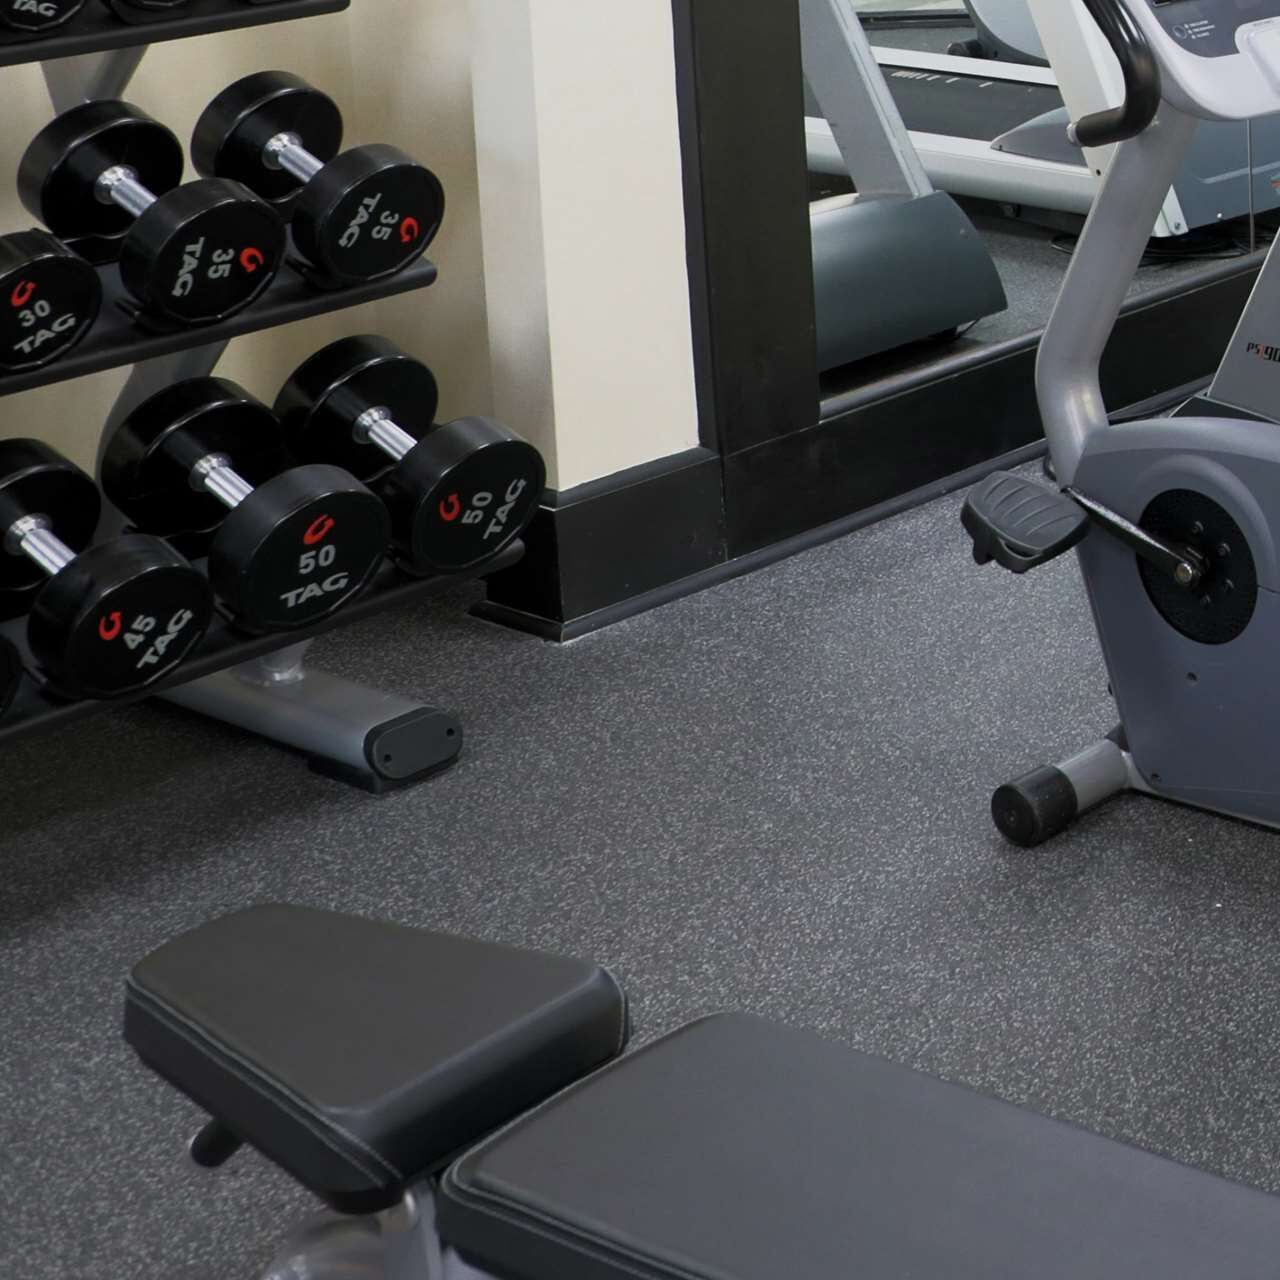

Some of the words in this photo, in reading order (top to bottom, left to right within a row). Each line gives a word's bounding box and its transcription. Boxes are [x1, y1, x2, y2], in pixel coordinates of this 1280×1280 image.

[339, 193, 382, 247] TAG
[371, 210, 399, 240] 35
[172, 237, 205, 297] TAG
[208, 248, 234, 279] 35
[19, 300, 50, 327] 30
[14, 312, 76, 353] TAG
[462, 492, 492, 524] 50
[483, 479, 526, 539] TAG
[299, 545, 335, 574] 50
[280, 572, 348, 607] TAG
[124, 615, 156, 649] 45
[136, 608, 193, 669] TAG
